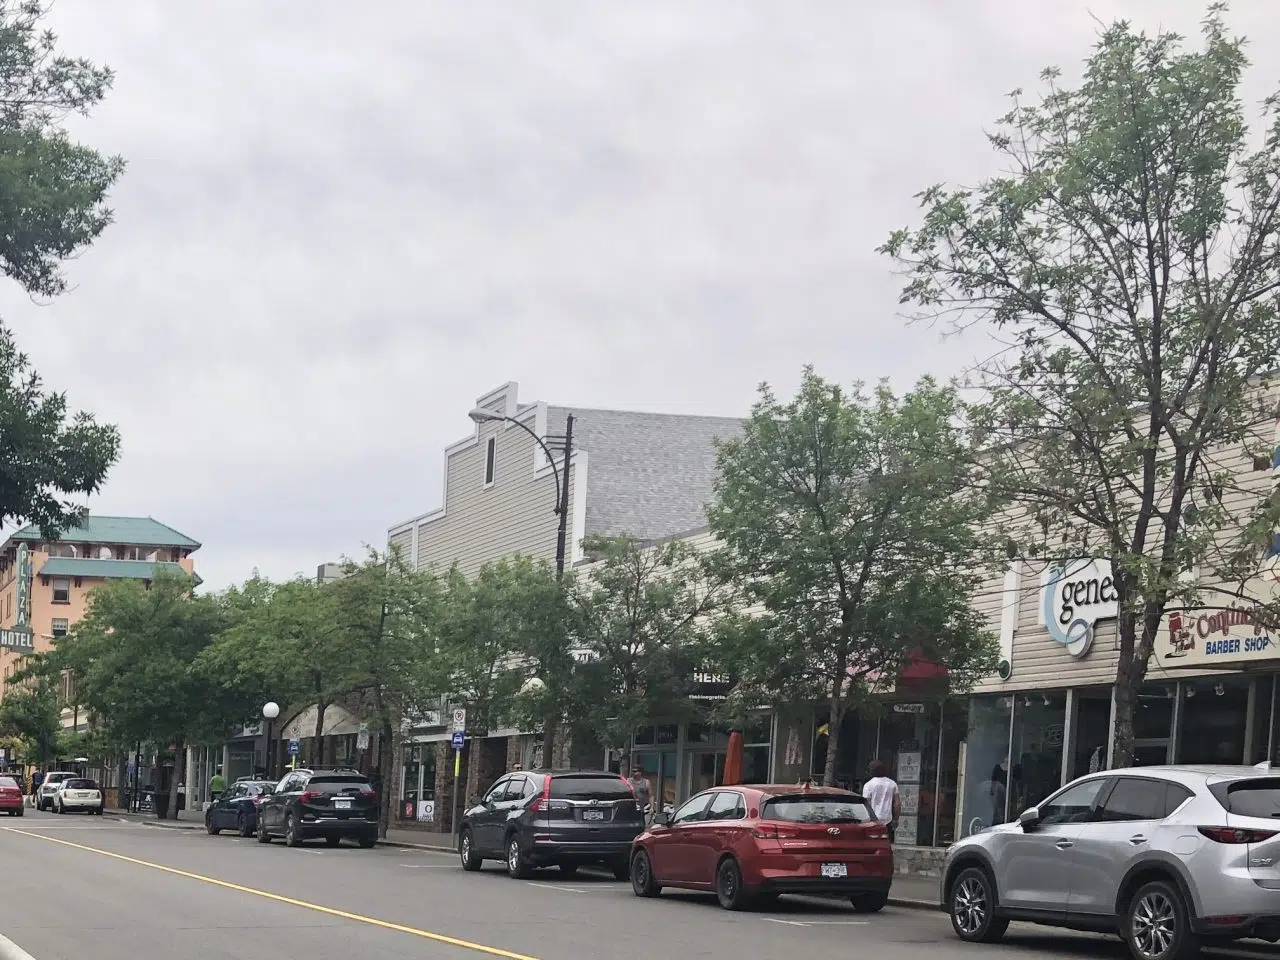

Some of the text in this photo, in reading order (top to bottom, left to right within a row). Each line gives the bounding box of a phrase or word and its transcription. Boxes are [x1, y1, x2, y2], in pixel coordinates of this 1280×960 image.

[18, 550, 27, 625] PLAZA
[1, 630, 33, 647] HOTEL
[1206, 636, 1269, 655] BARBER SHOP
[693, 672, 730, 683] HERE
